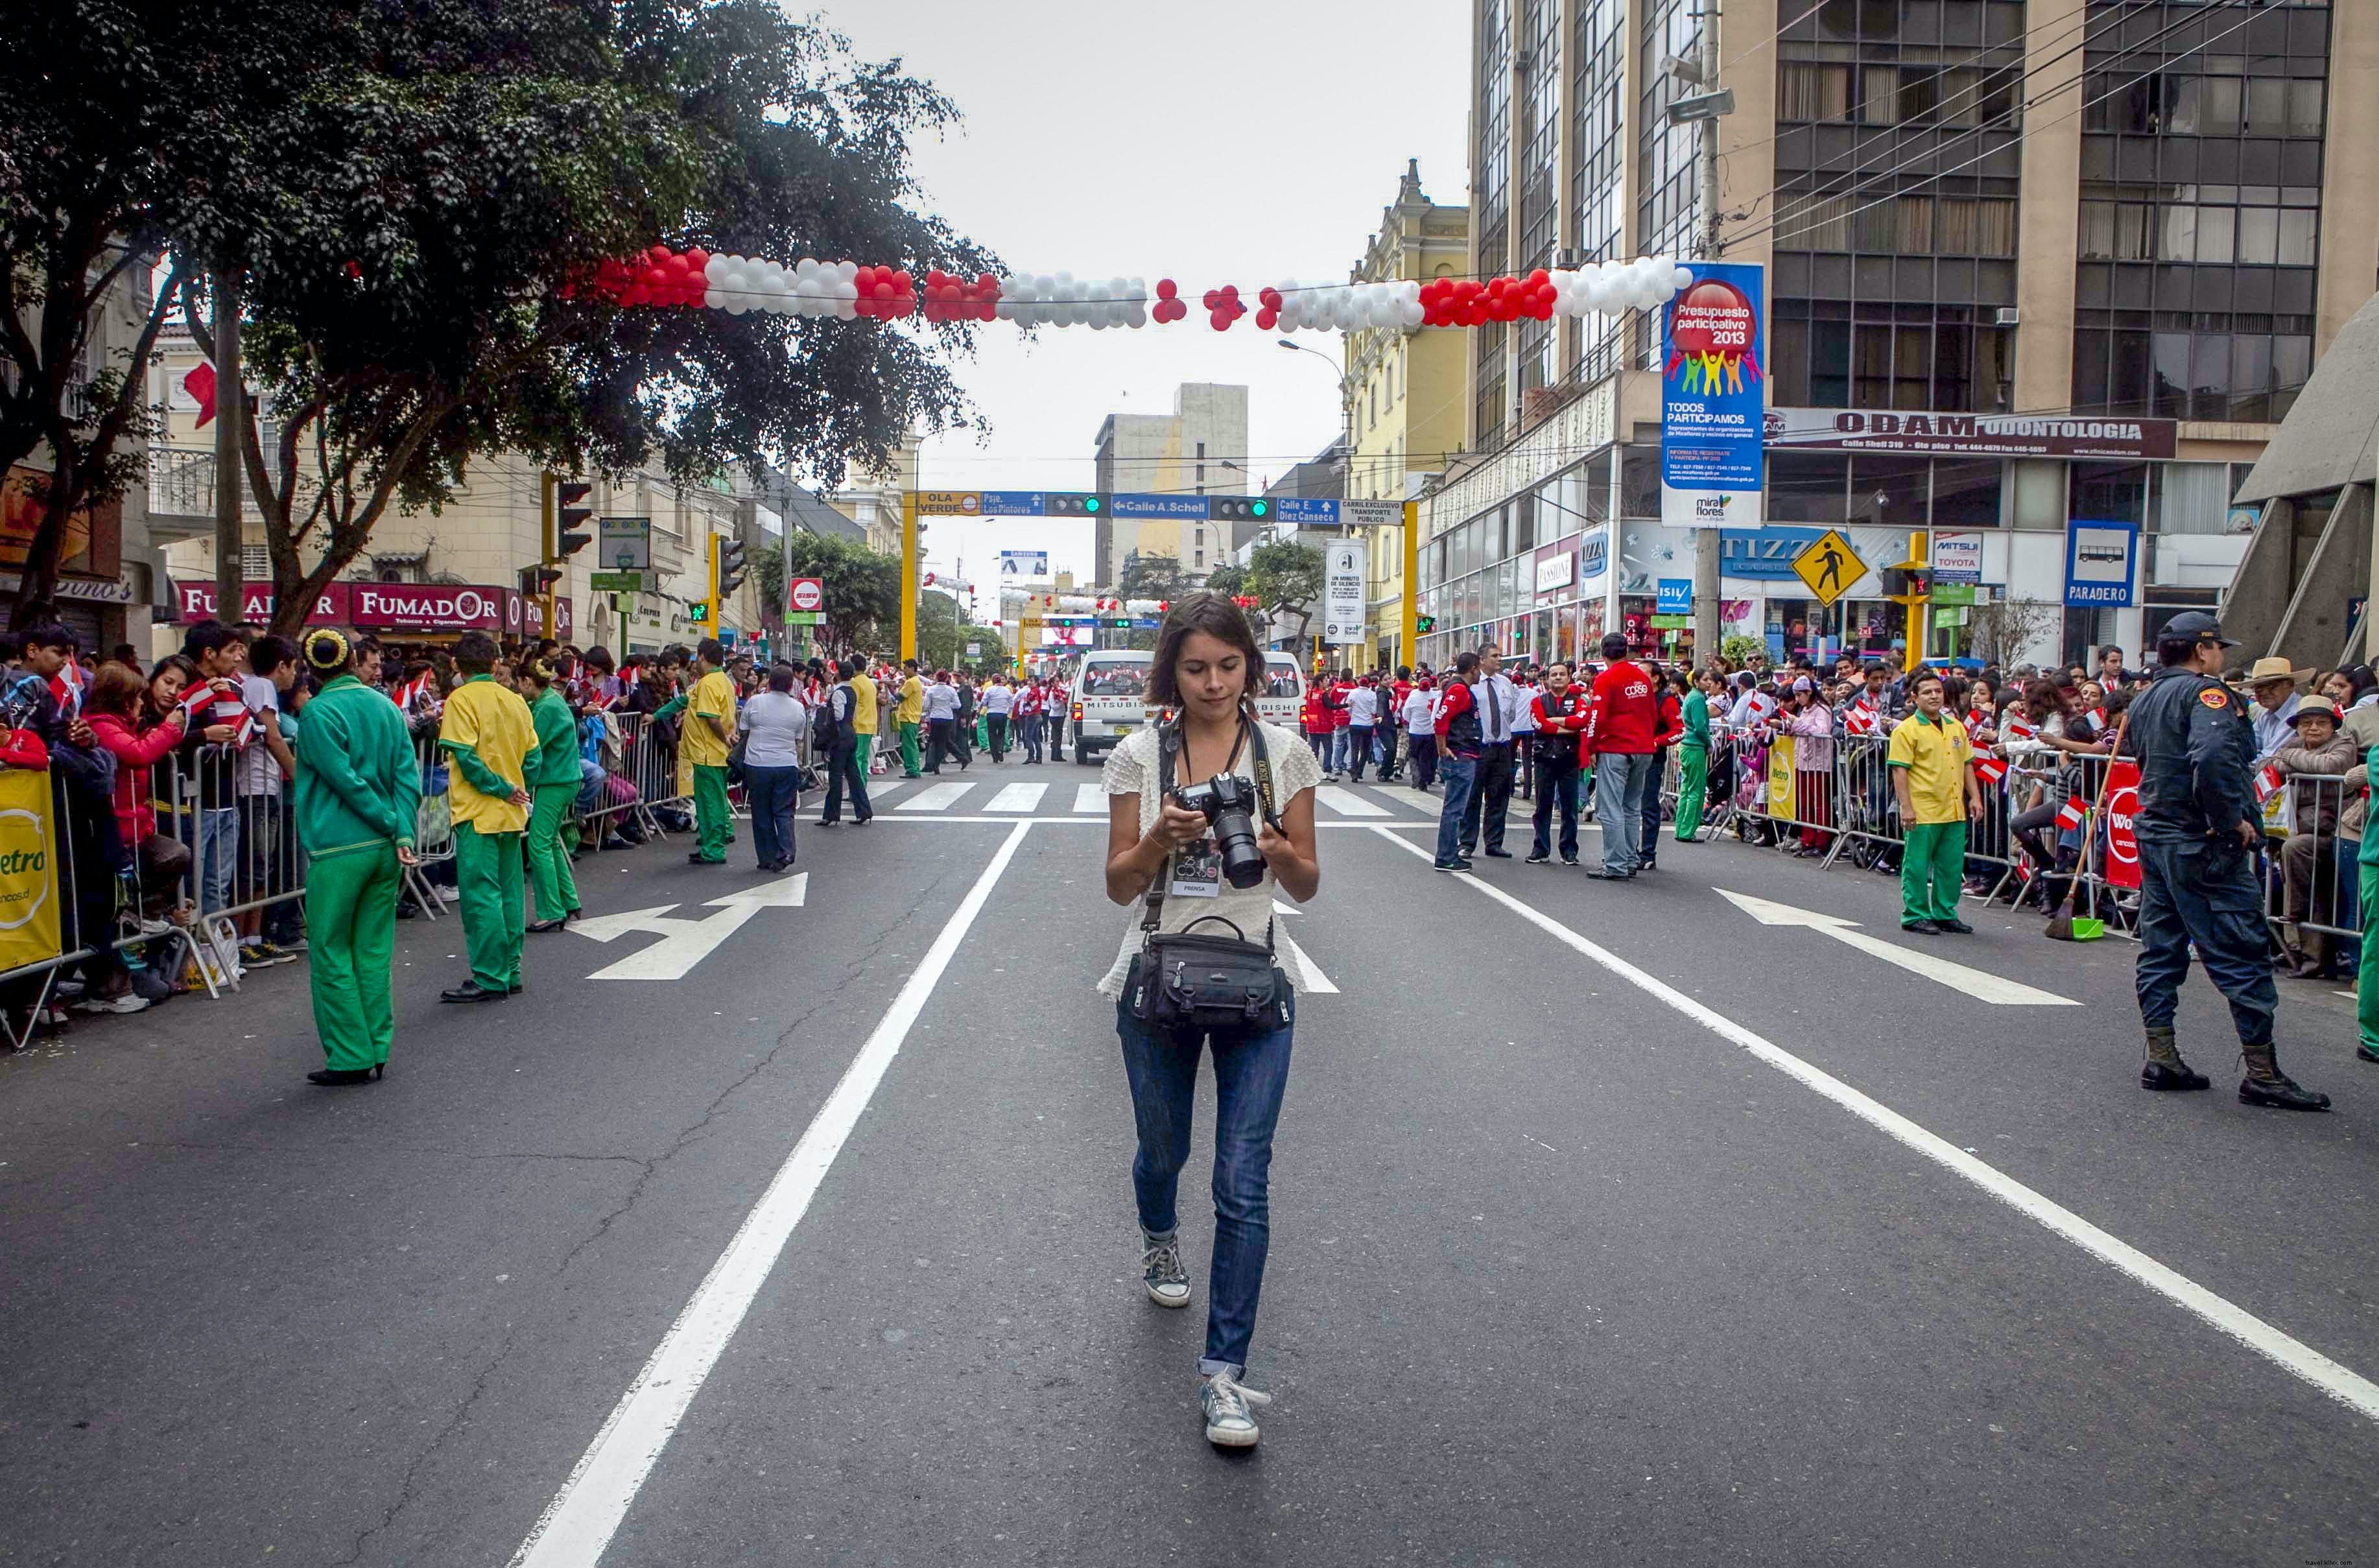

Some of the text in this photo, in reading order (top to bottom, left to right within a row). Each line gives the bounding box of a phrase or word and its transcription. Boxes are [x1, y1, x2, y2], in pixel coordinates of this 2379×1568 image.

[1678, 305, 1749, 319] Presupuesto
[1677, 318, 1746, 331] participativo
[1712, 331, 1746, 345] 2013
[1667, 403, 1705, 412] TODOS
[1667, 413, 1745, 424] PARTICIPAMOS
[1834, 412, 2142, 440] ODAM ODONTOLOGIA
[928, 493, 953, 502] OLA
[984, 493, 1003, 504] Psje.
[1696, 497, 1718, 506] mira
[921, 504, 960, 513] VERDE
[984, 505, 1030, 514] Los Pintores
[1126, 501, 1156, 512] Calle
[1169, 502, 1205, 513] Schell
[1280, 499, 1300, 510] Calle
[1280, 511, 1334, 522] Diez Canseco
[1696, 506, 1723, 516] flores
[1722, 539, 1813, 558] TIZZ
[1937, 541, 1978, 551] MITSUI
[1939, 558, 1976, 567] TOYOTA
[2069, 586, 2127, 601] PARADERO
[185, 589, 334, 614] FUAR
[361, 591, 497, 621] FUMADOR
[1587, 709, 1598, 737] Wong
[1773, 768, 1788, 781] Metro
[2112, 813, 2133, 830] Wo
[0, 849, 45, 875] etro
